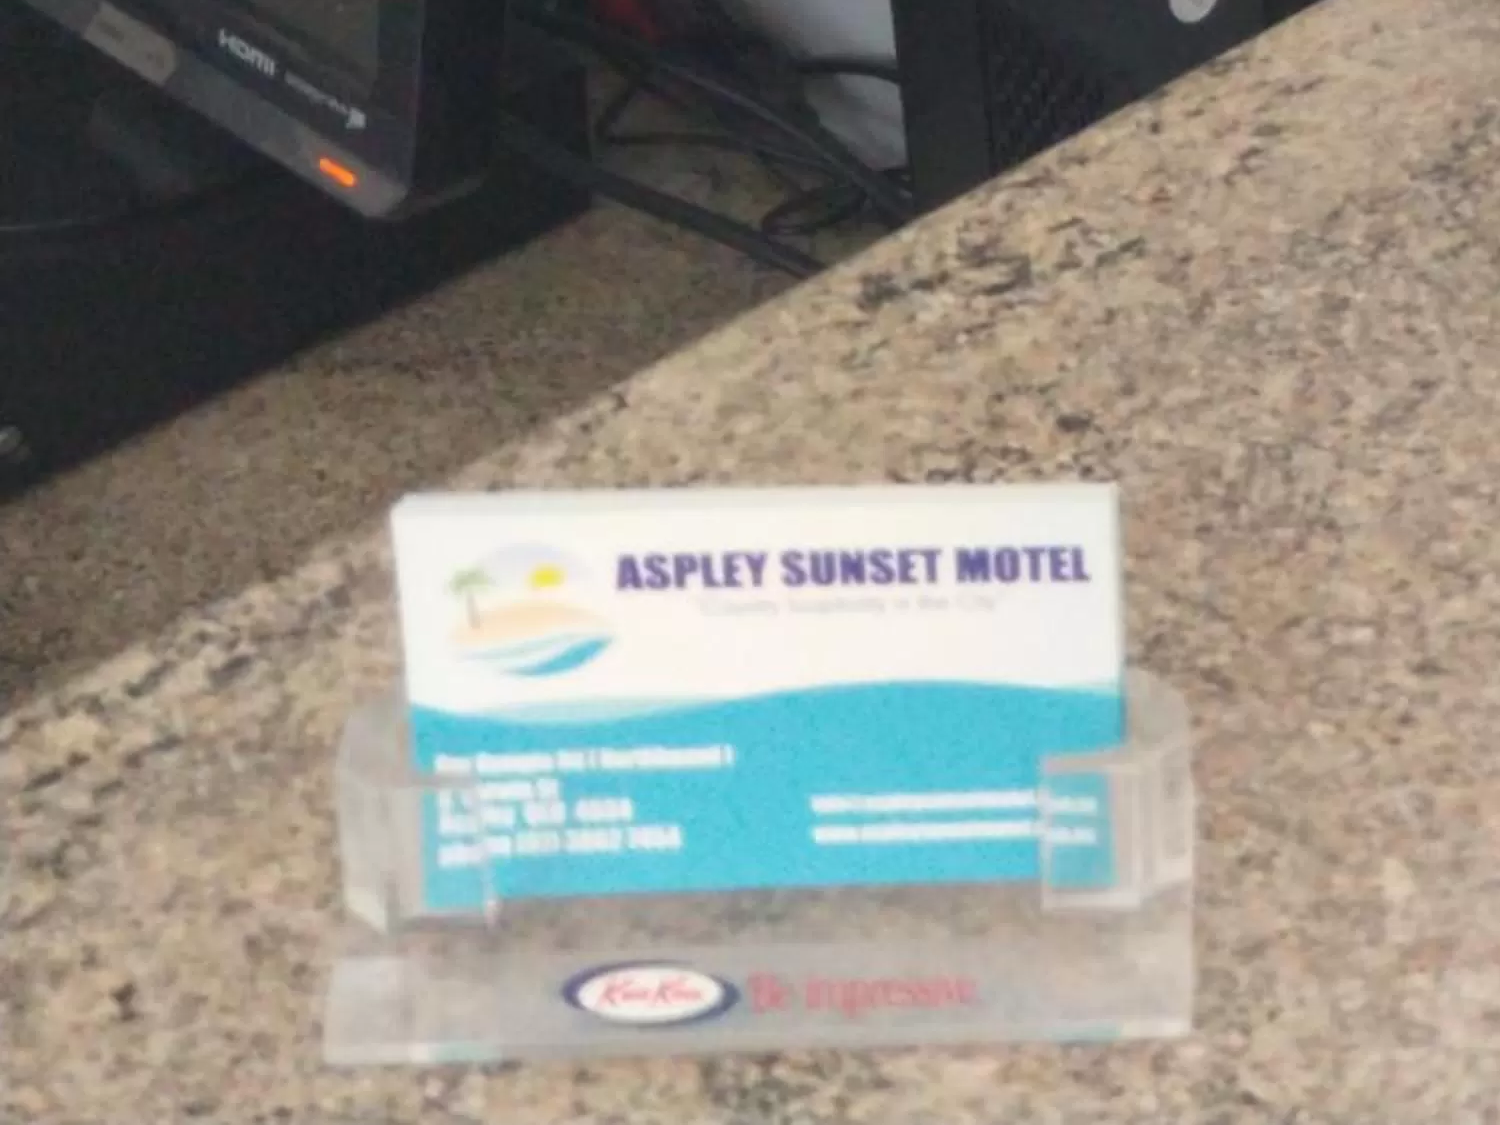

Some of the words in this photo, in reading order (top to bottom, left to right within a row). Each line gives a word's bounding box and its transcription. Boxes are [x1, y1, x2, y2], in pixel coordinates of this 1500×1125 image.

[218, 29, 276, 76] HDMI
[615, 551, 768, 592] ASPLEY
[781, 547, 942, 588] SUNSET
[955, 545, 1092, 585] MOTEL
